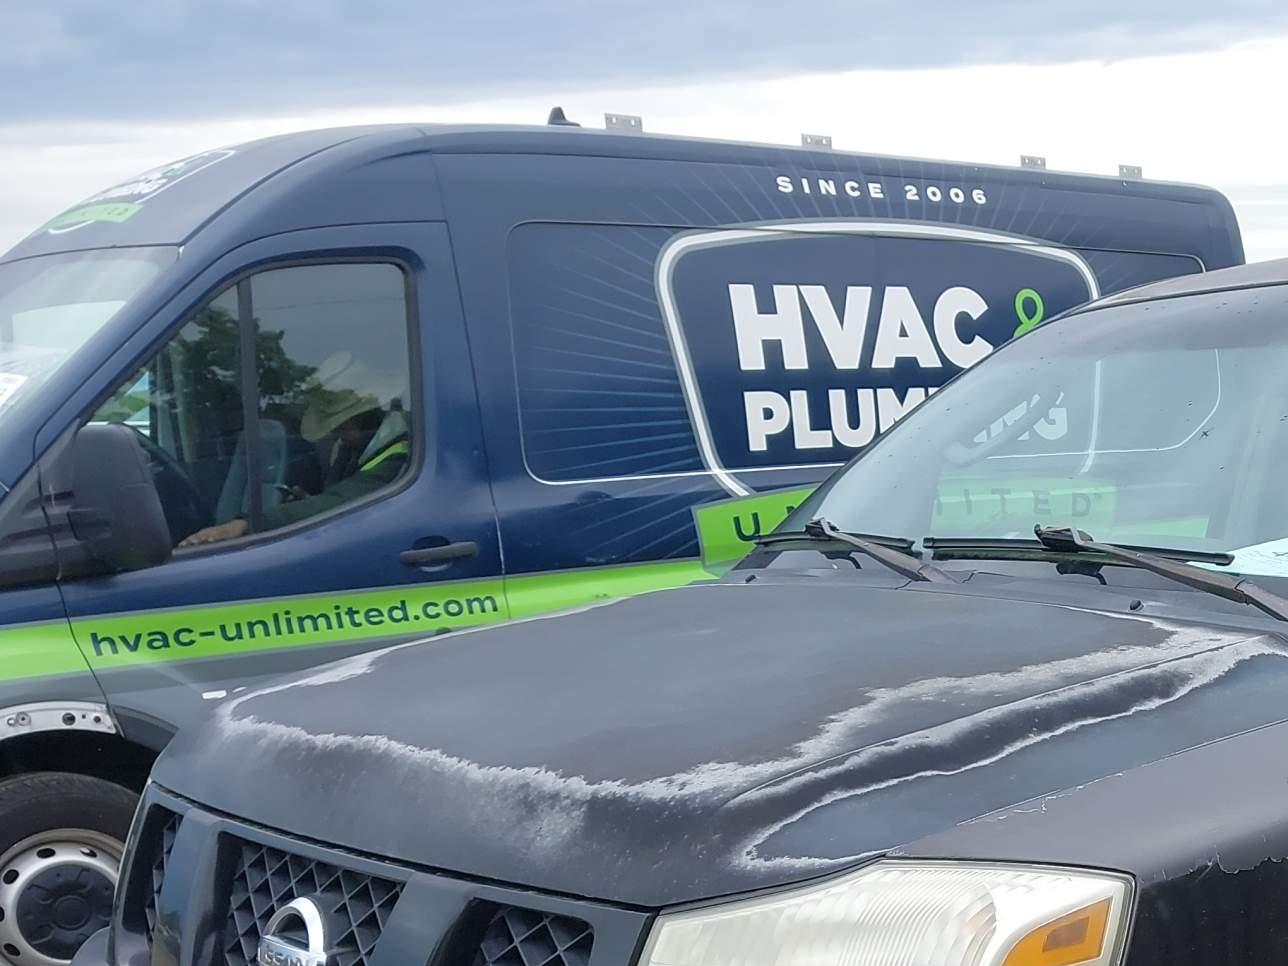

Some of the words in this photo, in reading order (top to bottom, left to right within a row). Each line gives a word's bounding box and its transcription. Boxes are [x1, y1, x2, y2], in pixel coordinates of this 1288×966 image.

[776, 176, 884, 198] SINCE
[904, 185, 987, 204] 2006
[728, 283, 994, 370] HVAC
[90, 592, 499, 657] hvac-unlimited.com
